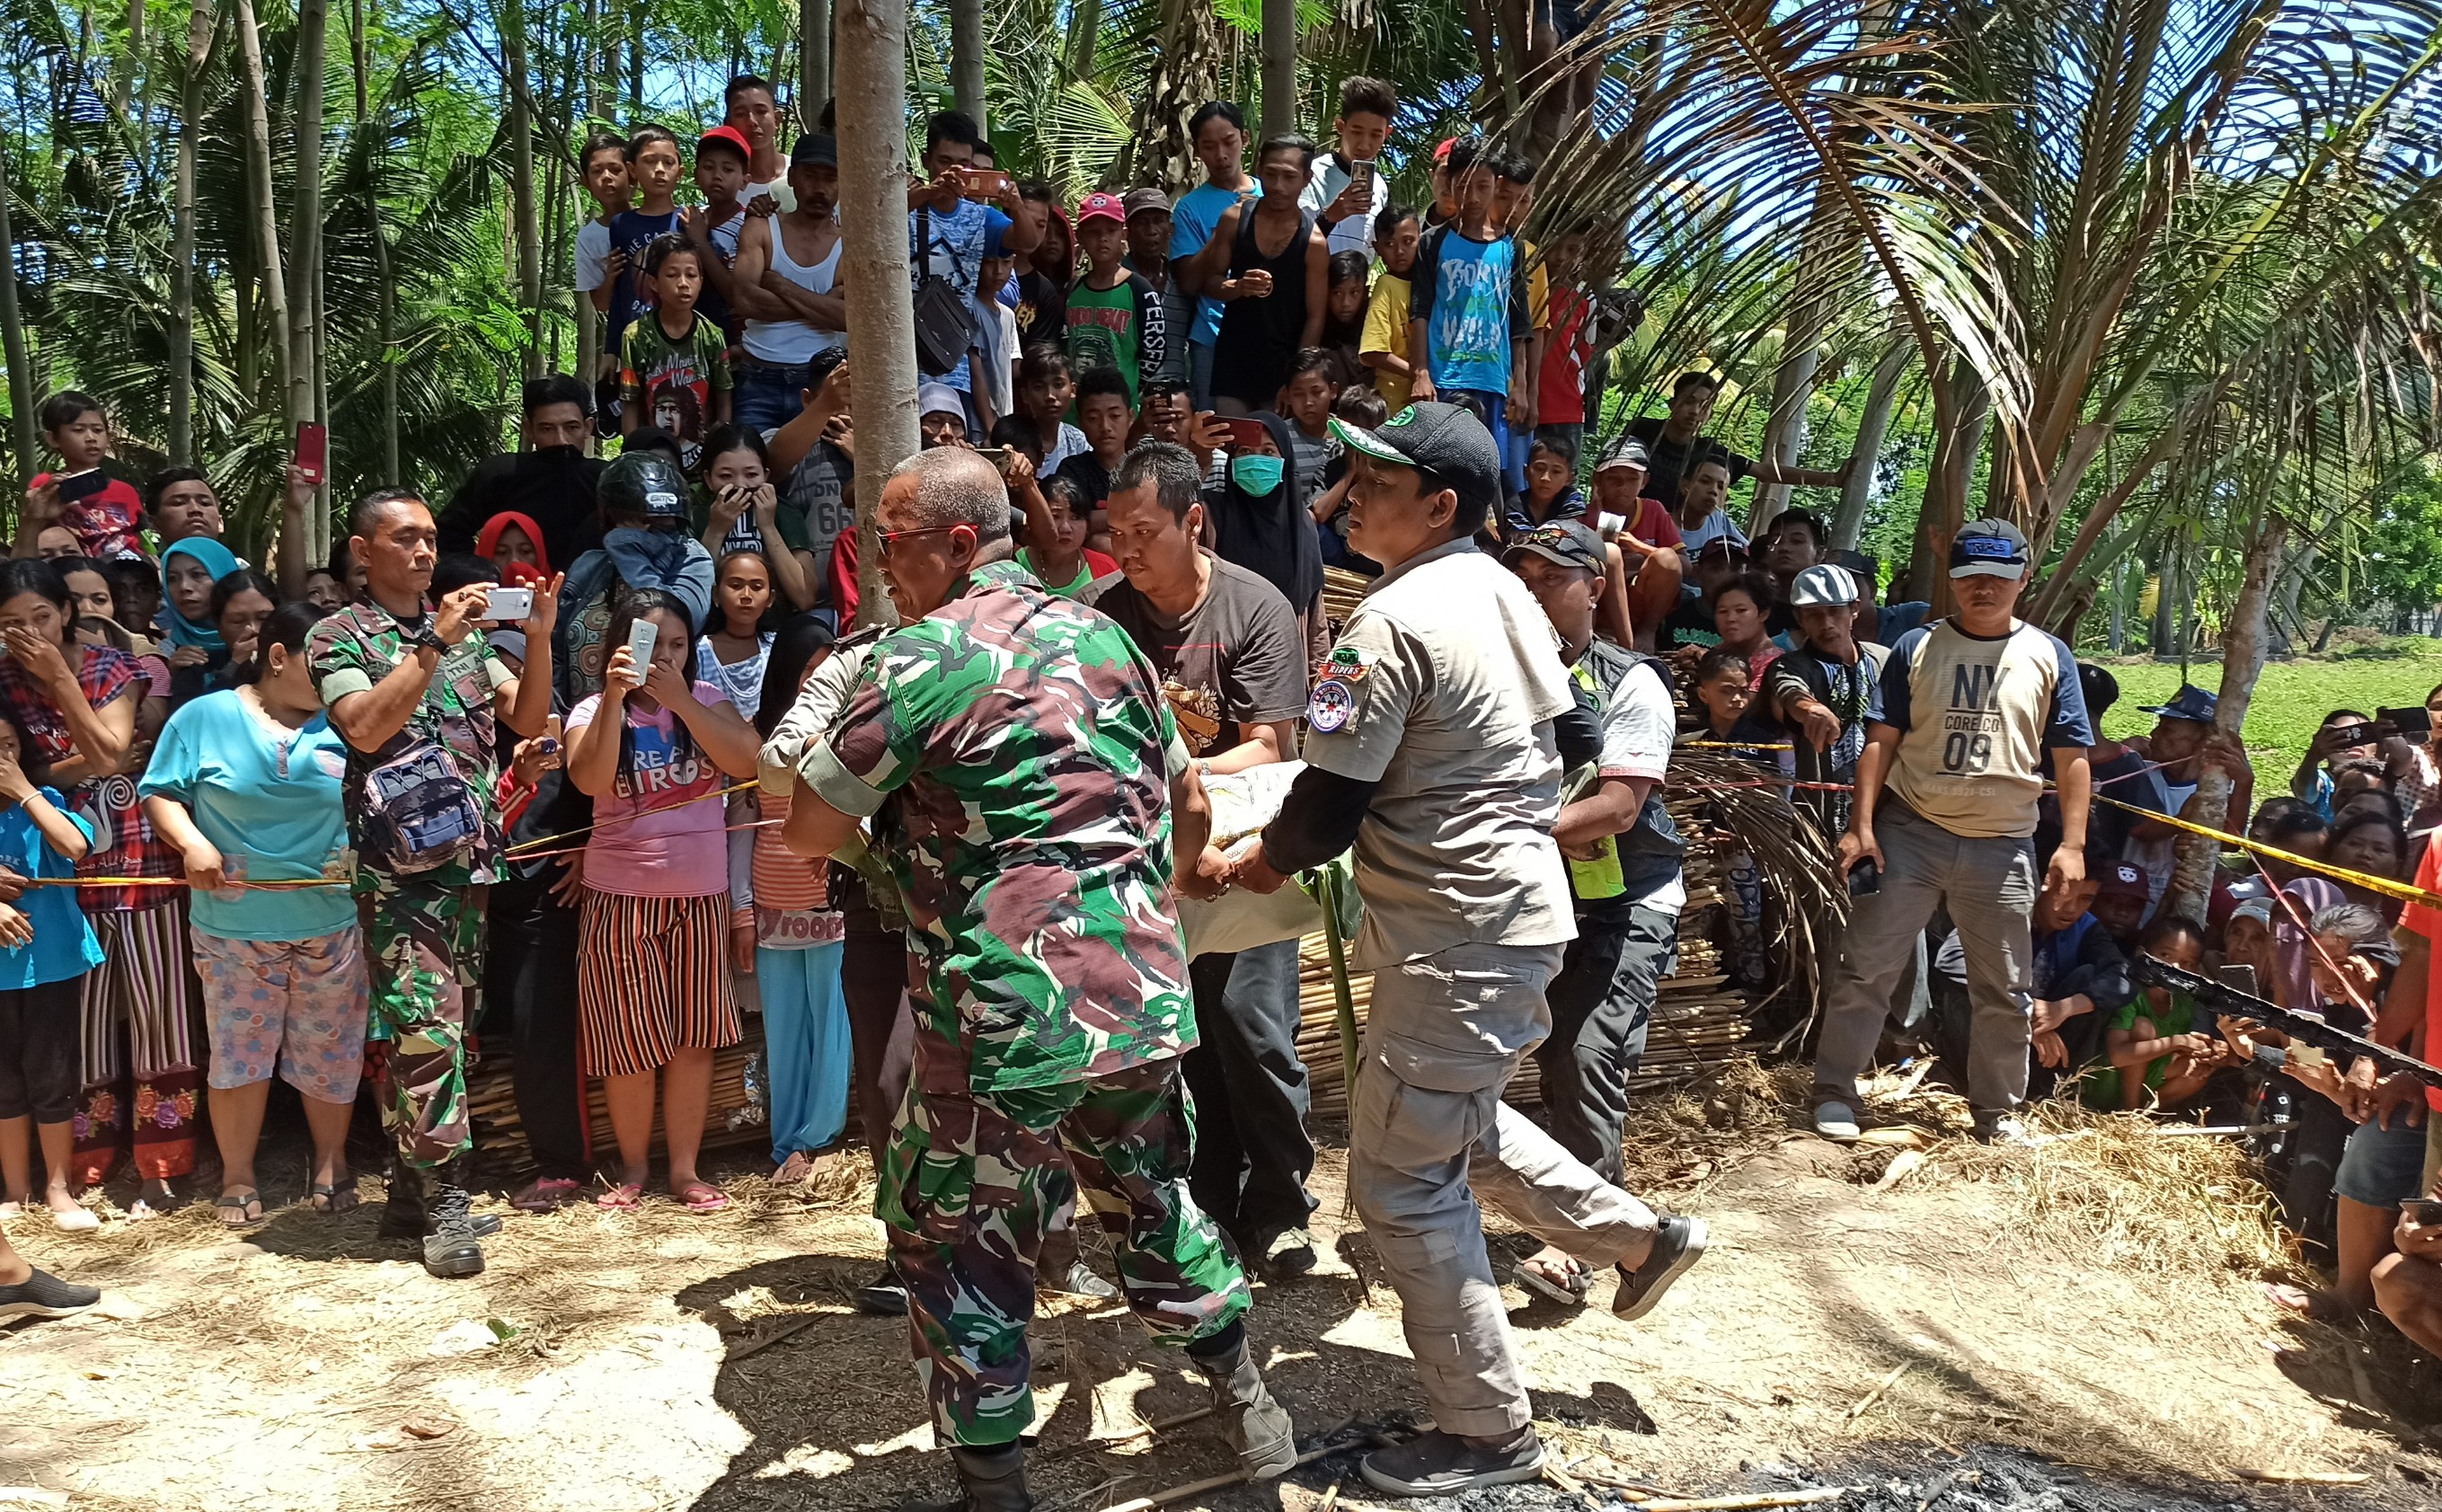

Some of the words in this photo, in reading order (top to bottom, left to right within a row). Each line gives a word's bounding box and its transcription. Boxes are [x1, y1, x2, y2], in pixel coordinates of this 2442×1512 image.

[817, 502, 854, 535] 66
[449, 662, 470, 676] TNI
[1328, 665, 1360, 676] RIDERS
[1951, 663, 2011, 711] NY
[1943, 732, 1992, 774] 09
